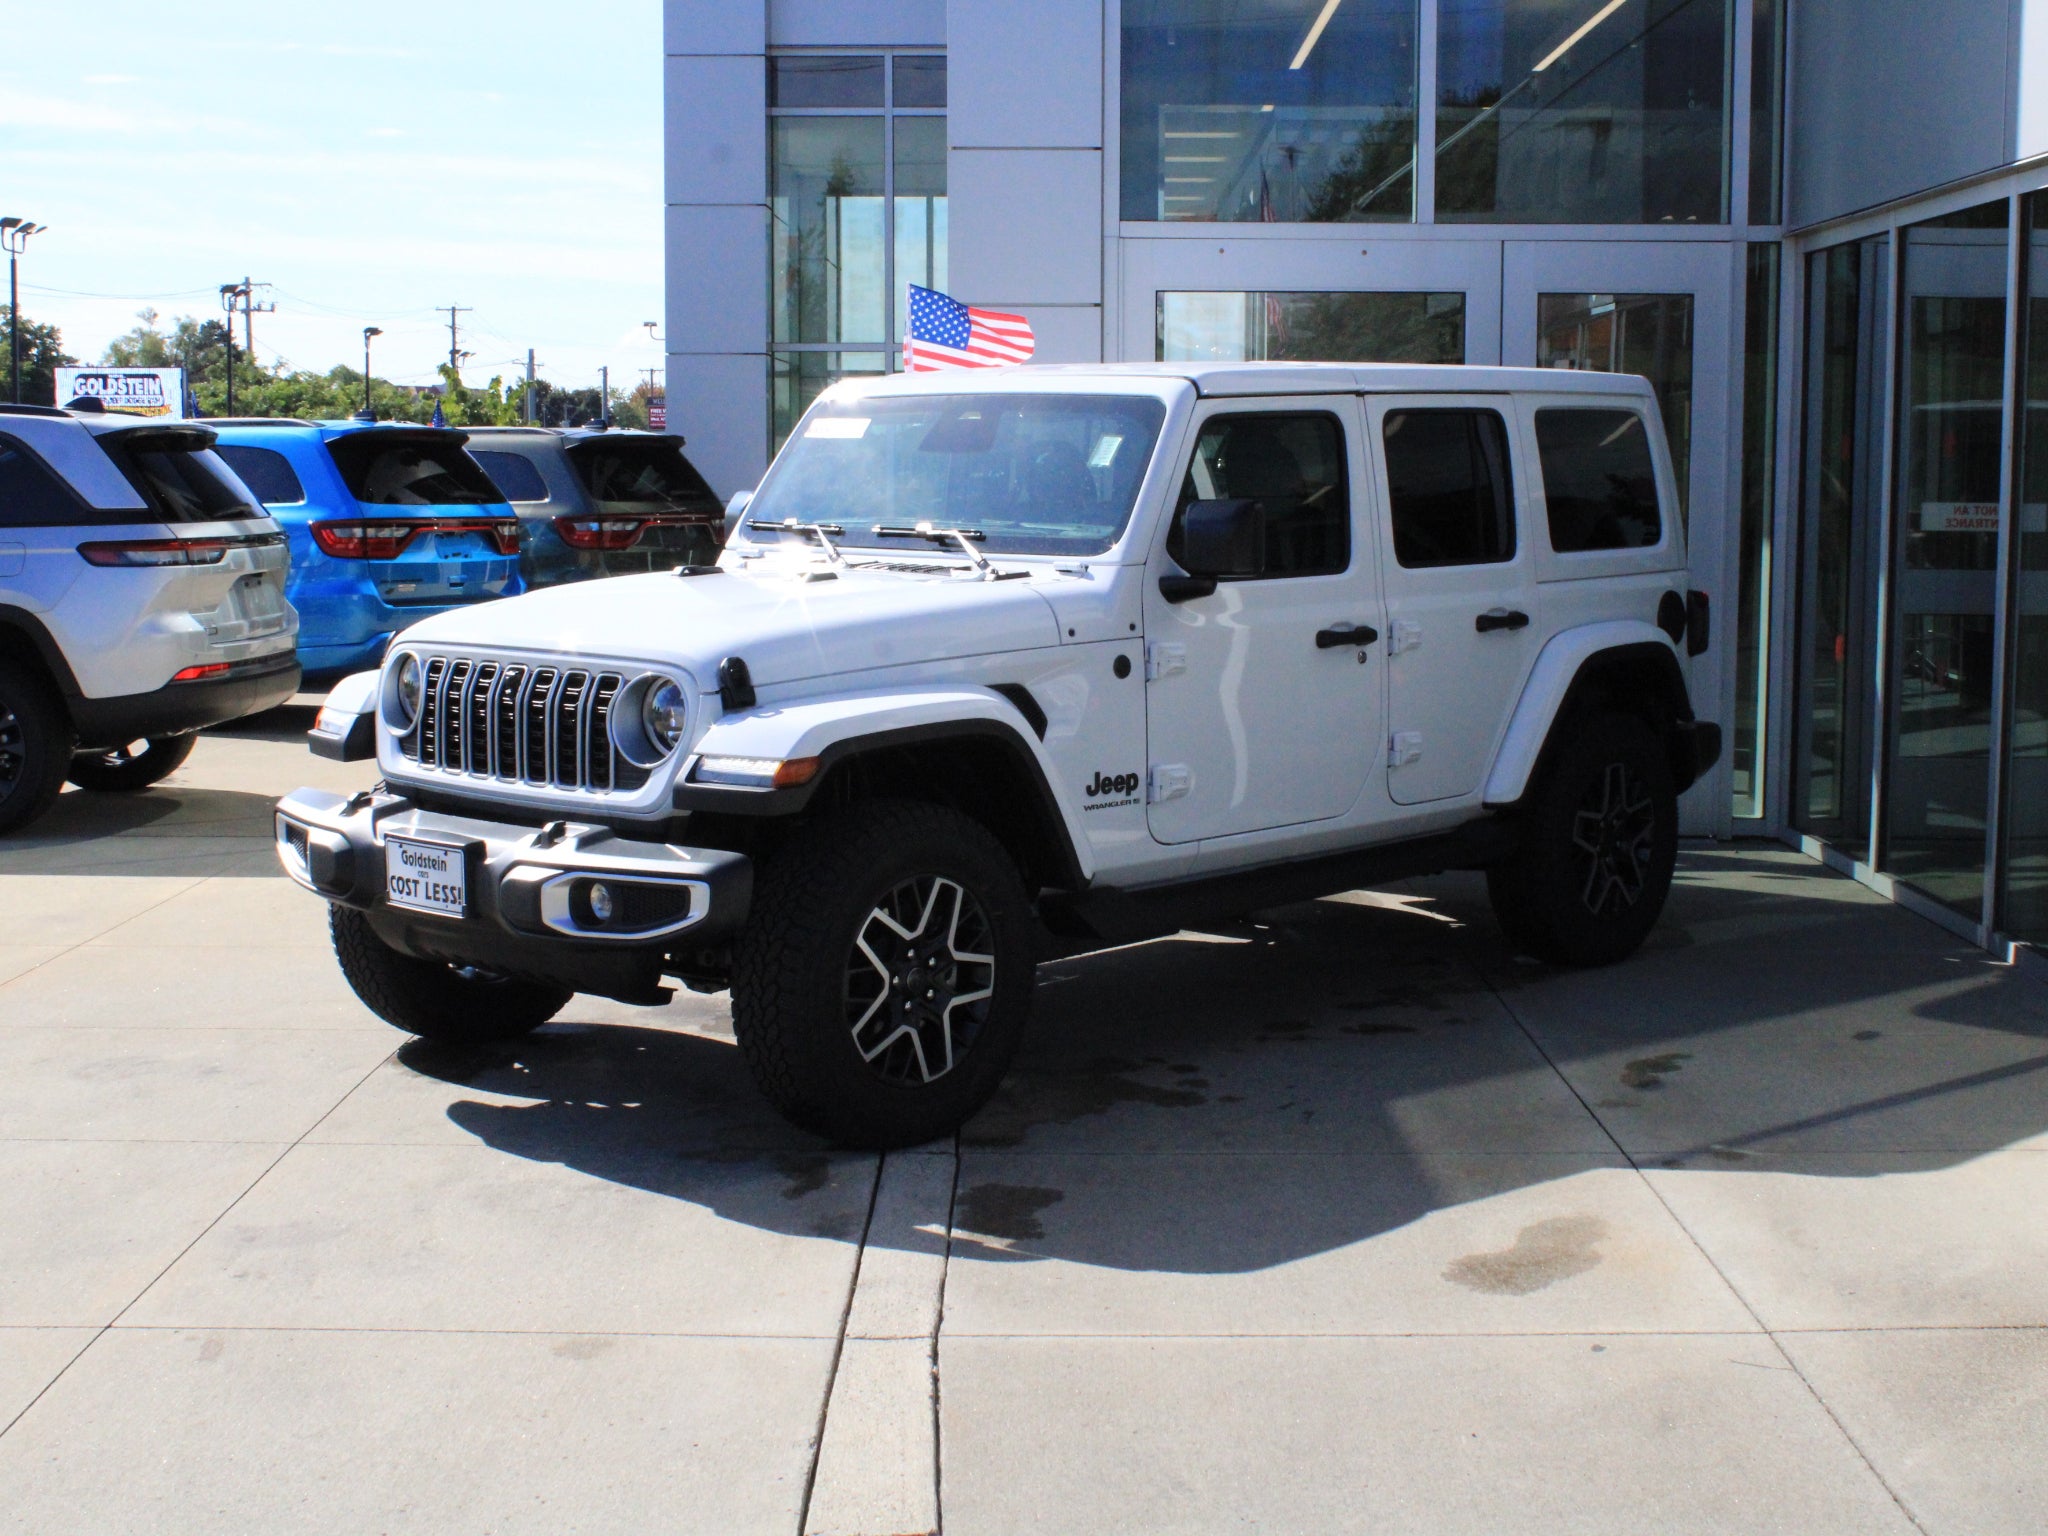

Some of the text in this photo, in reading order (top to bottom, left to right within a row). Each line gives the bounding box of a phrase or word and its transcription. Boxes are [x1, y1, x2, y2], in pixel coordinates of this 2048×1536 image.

[74, 377, 161, 395] GOLDSTEIN
[1086, 771, 1139, 797] Jeep
[1083, 799, 1132, 812] WRANGLER
[401, 849, 447, 872] Goldstein
[390, 875, 462, 906] COST LESS!
